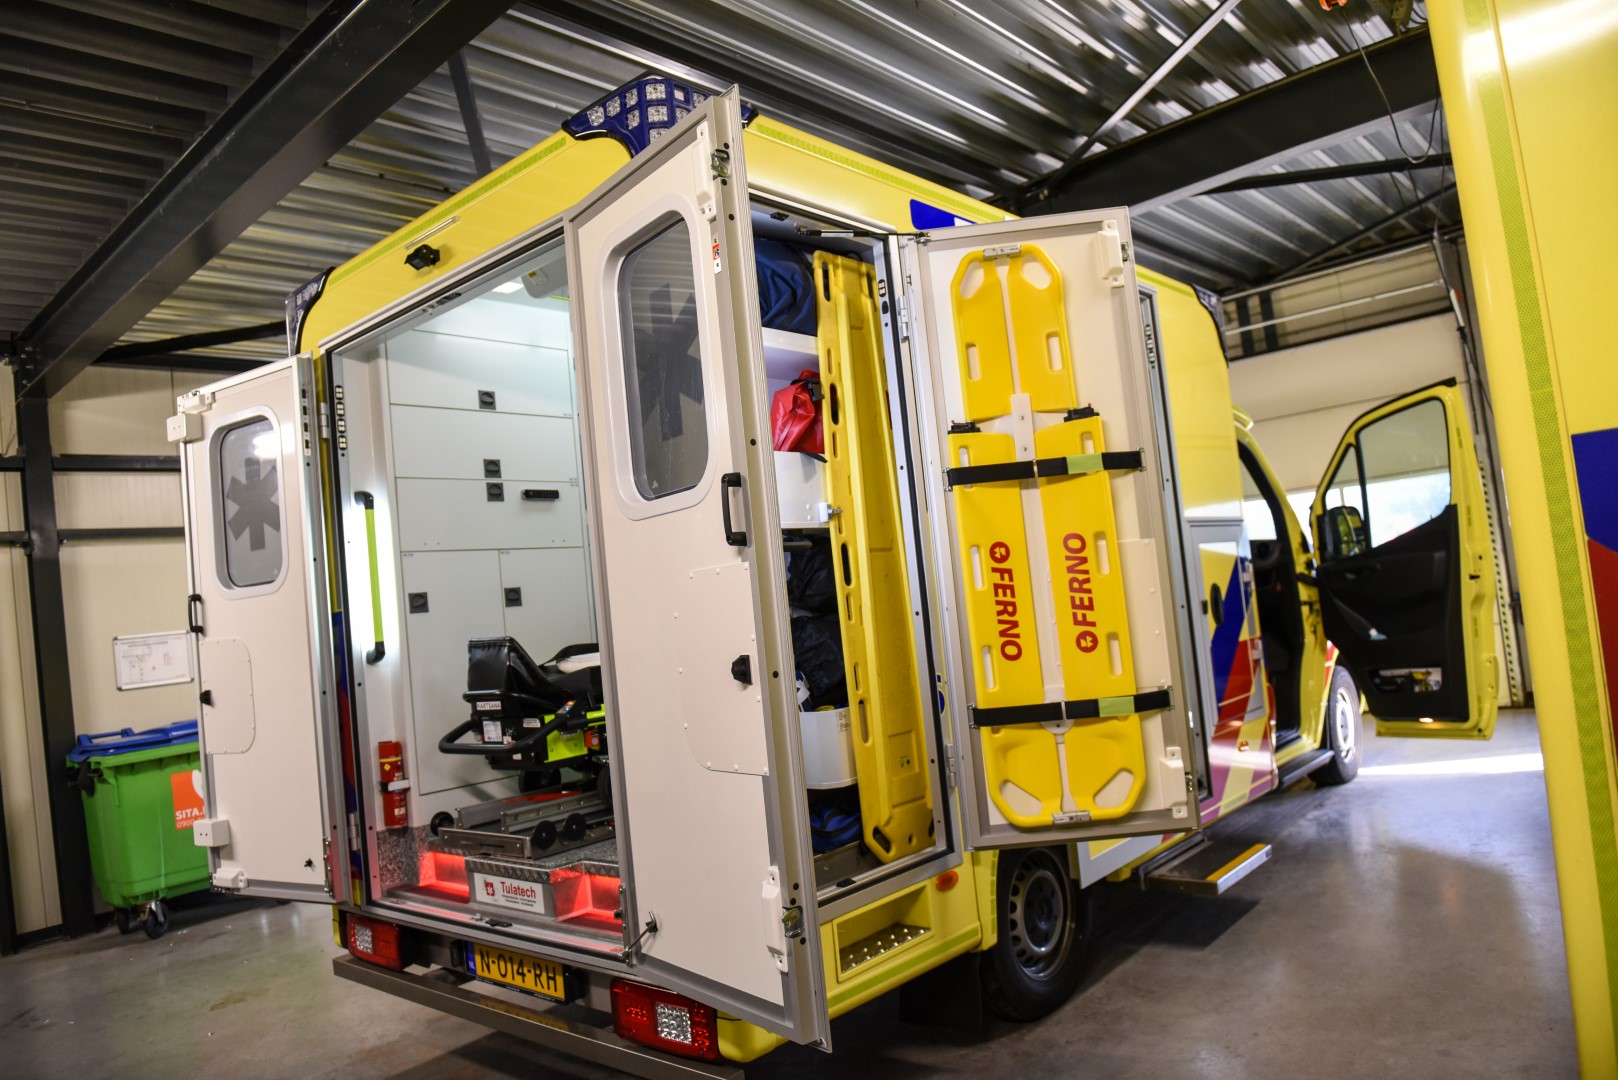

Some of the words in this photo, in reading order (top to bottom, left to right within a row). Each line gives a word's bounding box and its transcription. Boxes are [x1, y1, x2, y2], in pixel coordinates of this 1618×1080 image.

[991, 567, 1023, 661] FERNO
[1063, 533, 1097, 627] FERNO
[500, 881, 536, 898] Tulatech
[479, 949, 557, 992] N-014-RH
